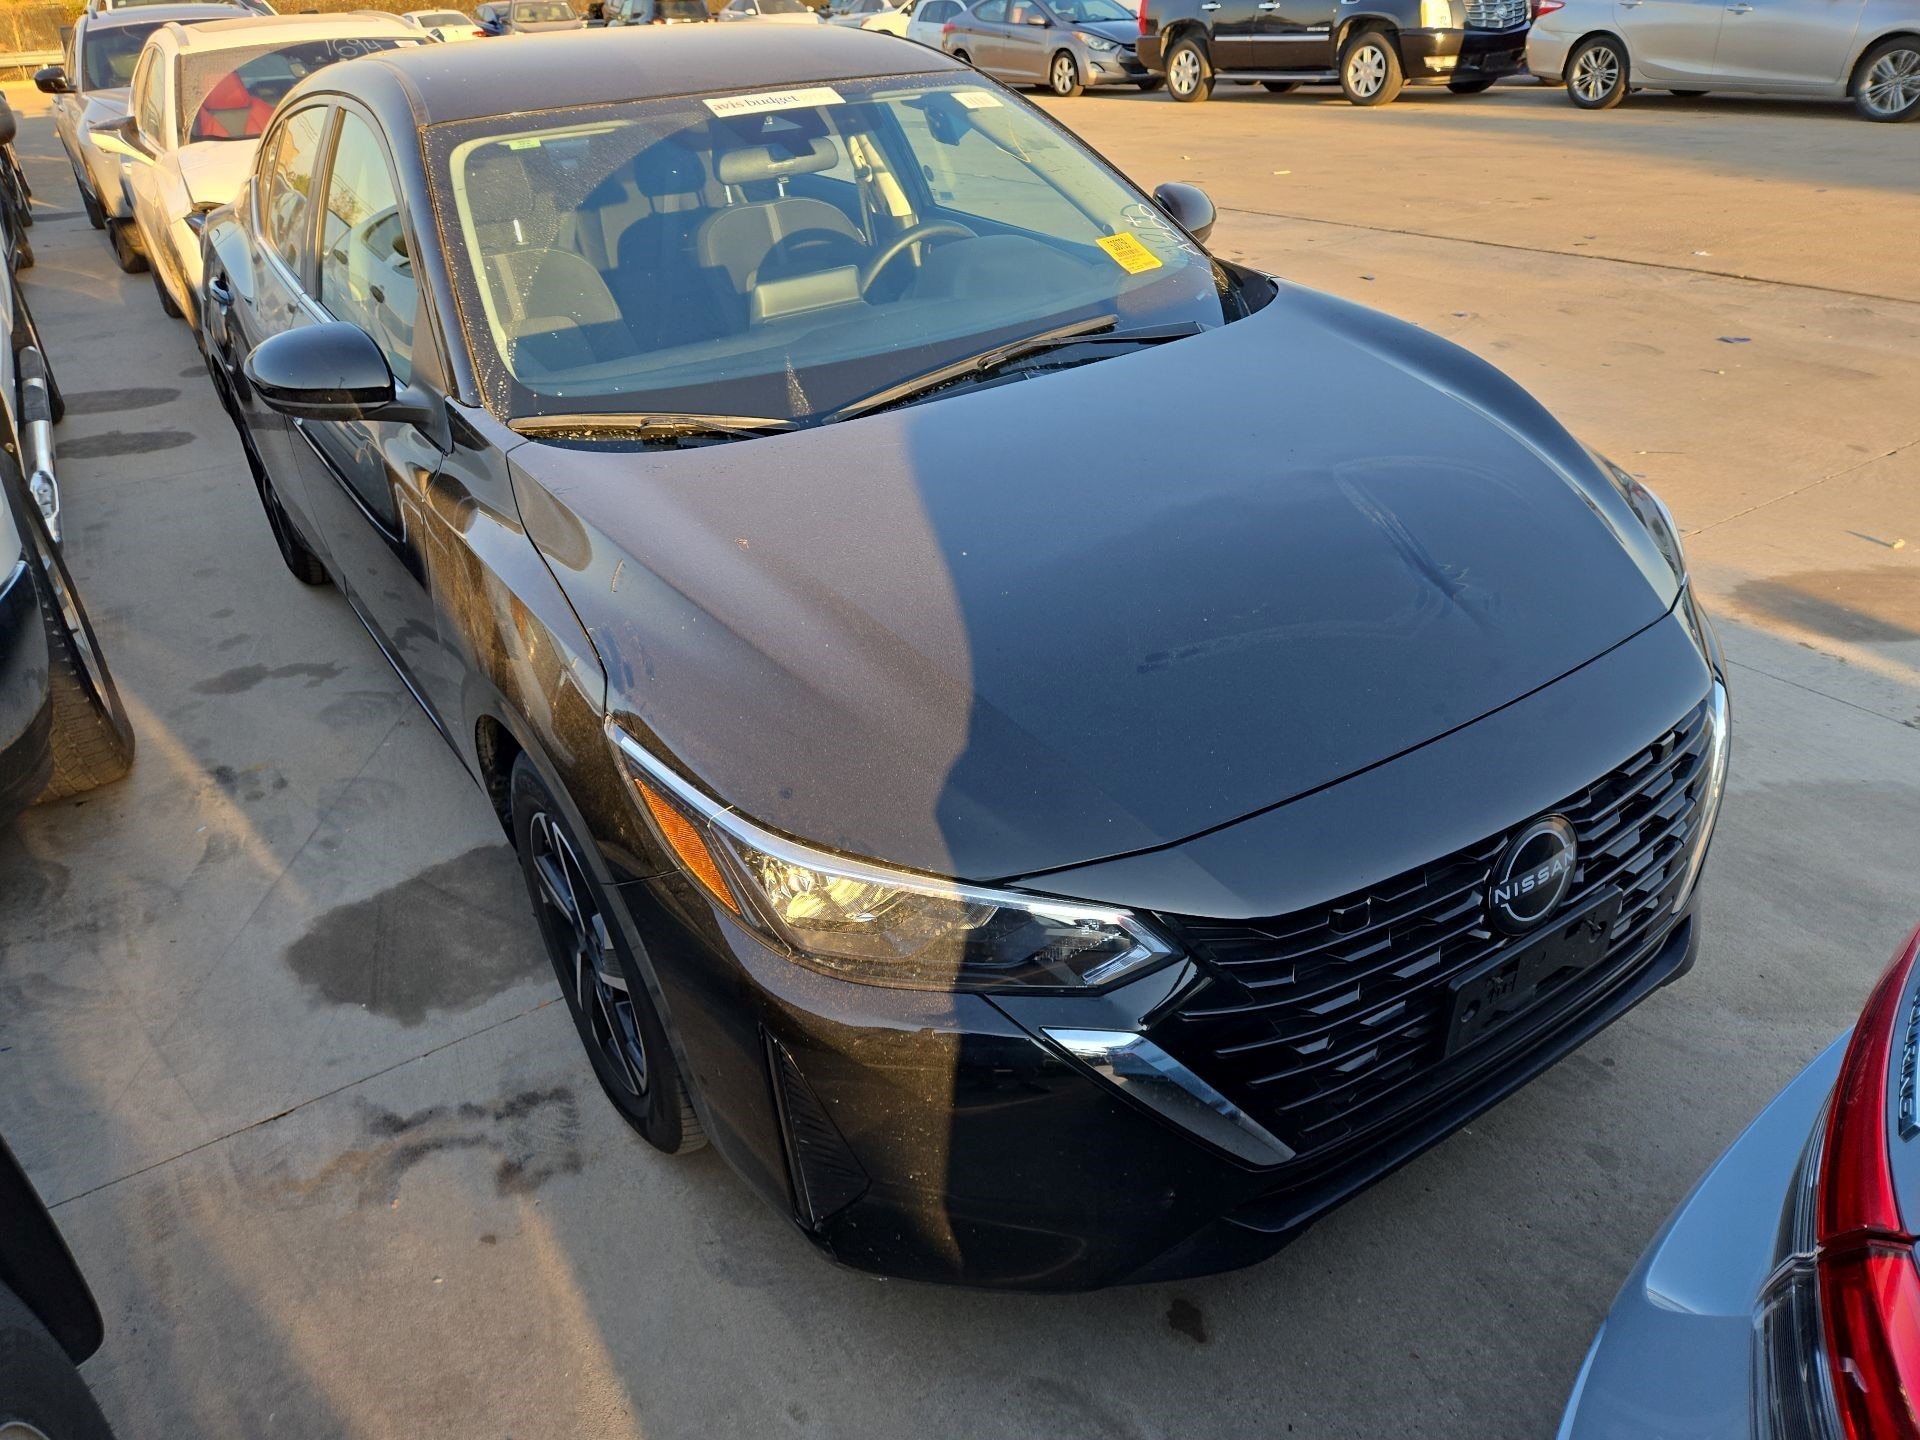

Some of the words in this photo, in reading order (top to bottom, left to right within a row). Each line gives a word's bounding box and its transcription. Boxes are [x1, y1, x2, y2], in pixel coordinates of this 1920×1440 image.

[713, 99, 745, 111] avis
[744, 95, 800, 107] budget
[1494, 844, 1574, 904] NISSAN
